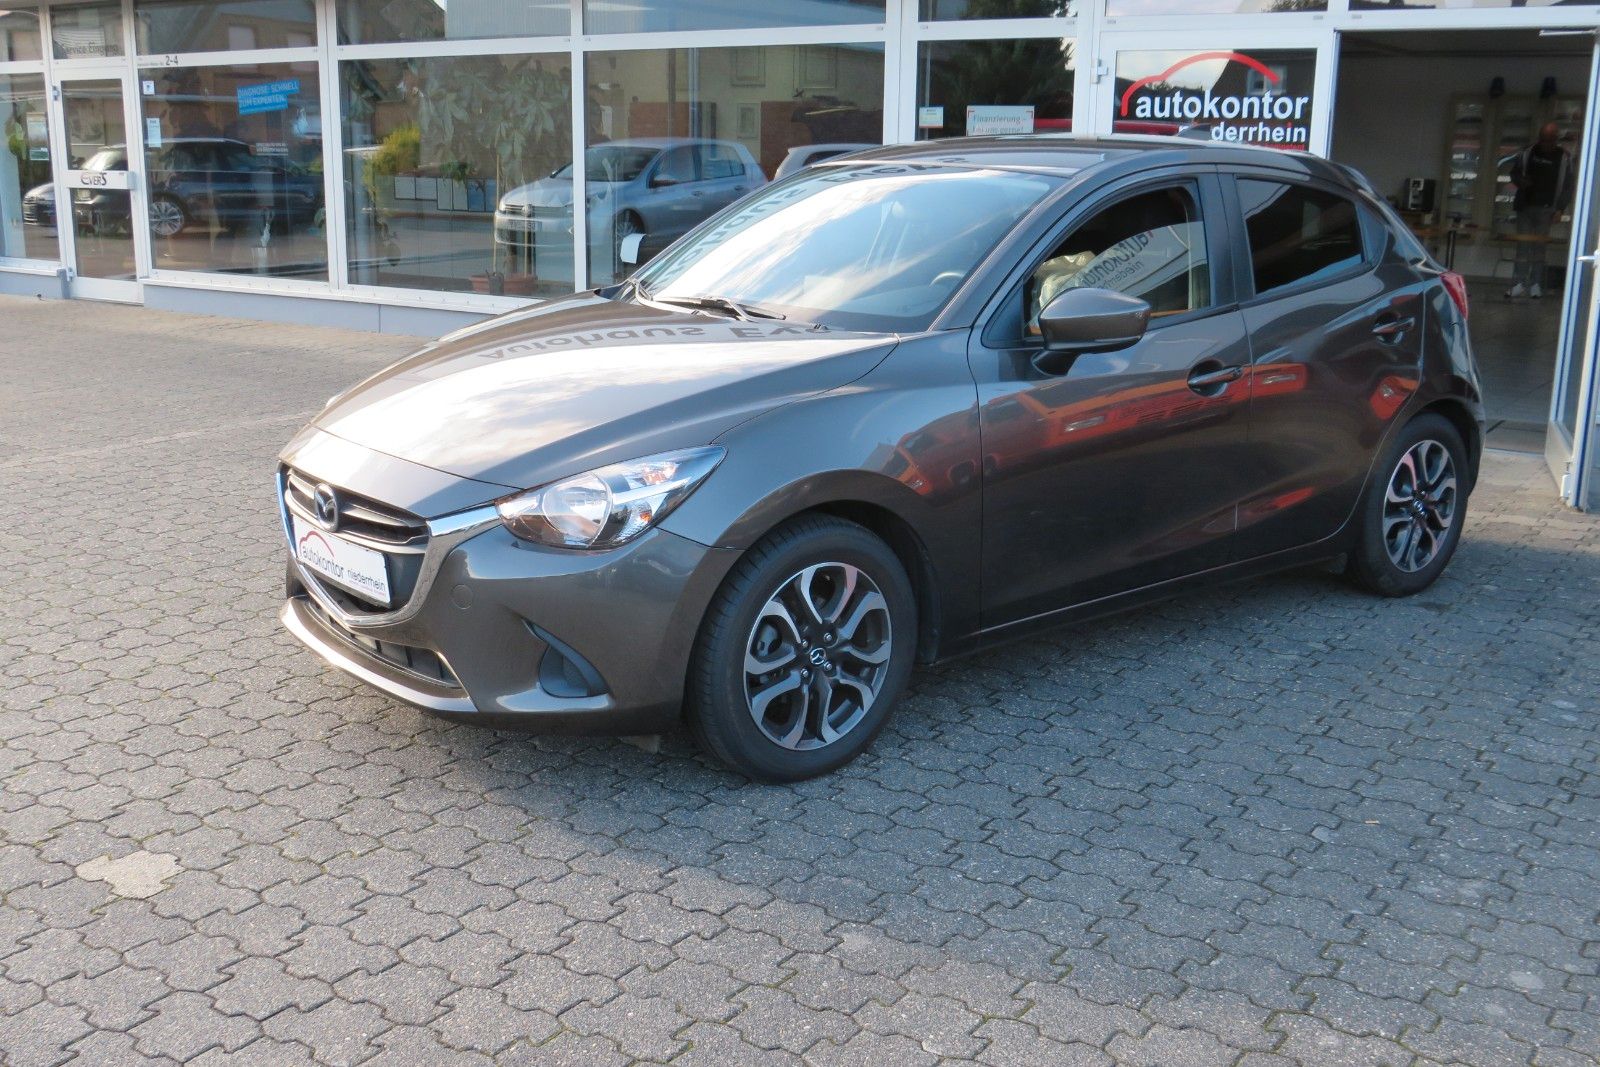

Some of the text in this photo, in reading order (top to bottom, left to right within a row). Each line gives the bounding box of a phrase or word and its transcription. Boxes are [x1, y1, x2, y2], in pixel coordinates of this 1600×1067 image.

[165, 55, 179, 66] 2-4
[1135, 89, 1309, 120] autokontor
[302, 545, 345, 579] autokontor
